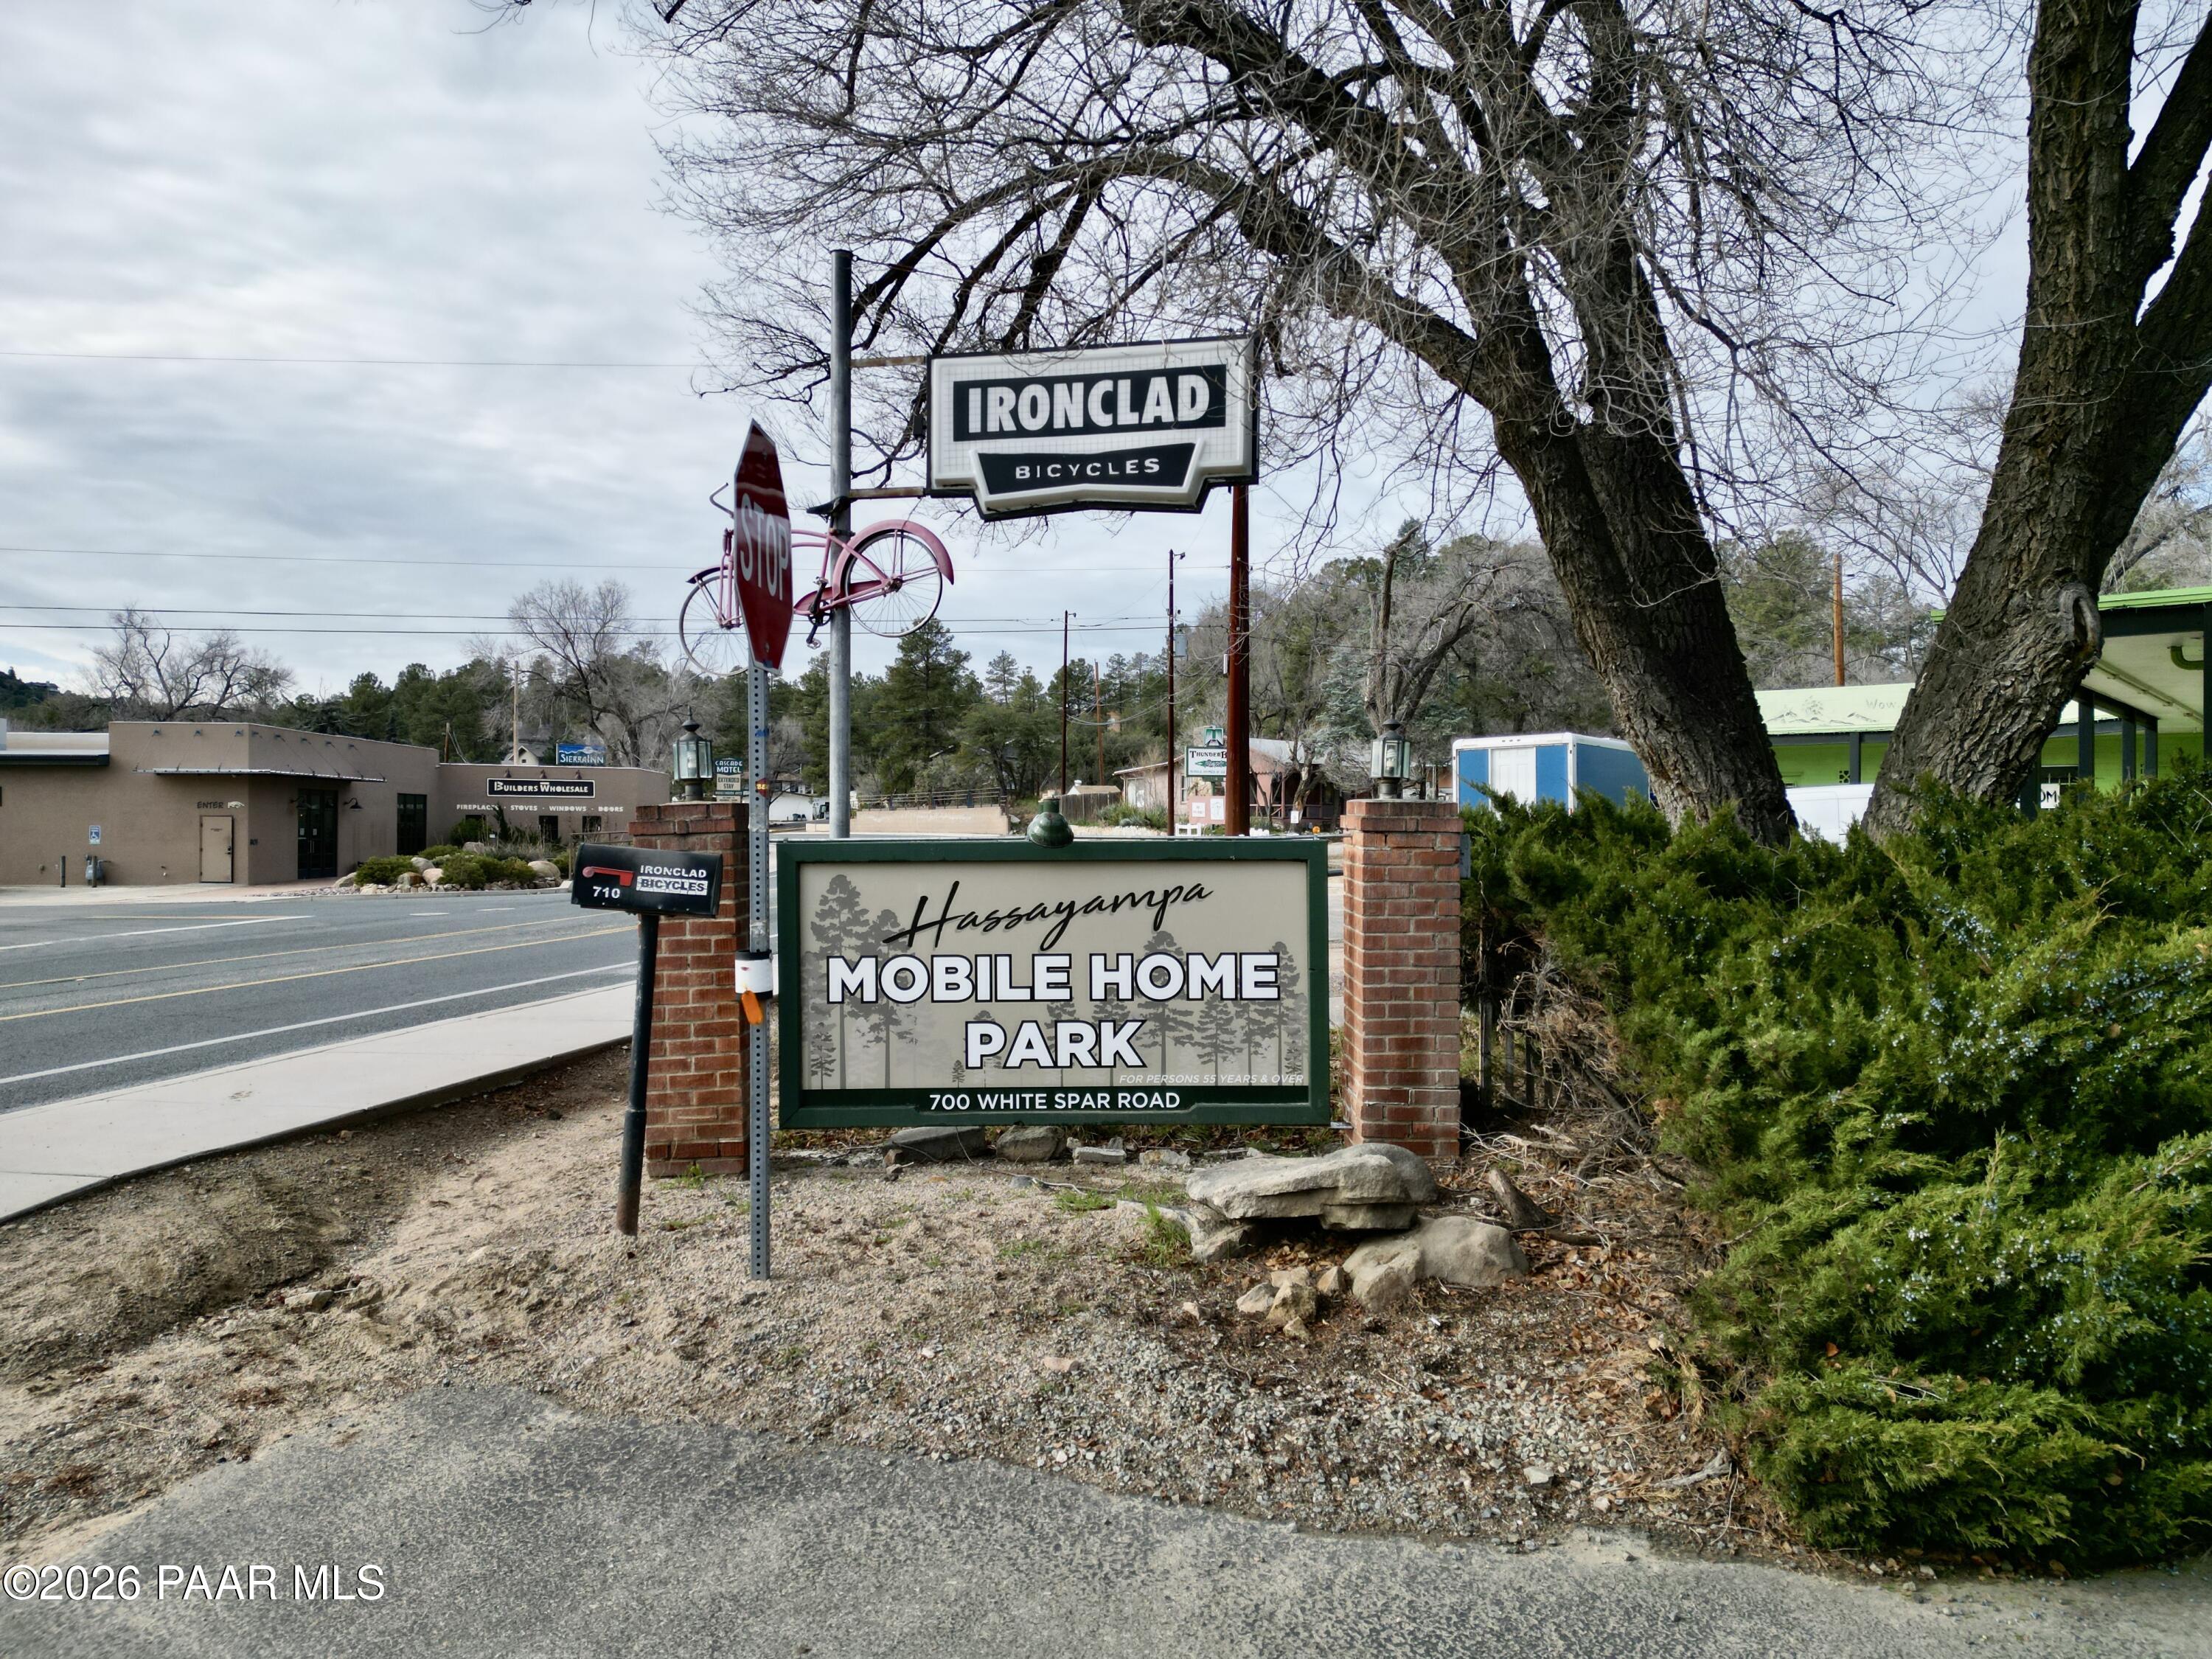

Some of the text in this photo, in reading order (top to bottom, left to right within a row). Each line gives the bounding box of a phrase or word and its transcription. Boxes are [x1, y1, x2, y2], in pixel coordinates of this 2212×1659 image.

[968, 374, 1210, 434] IRONCLAD
[1015, 458, 1161, 479] BICYCLES
[740, 493, 789, 601] STOP
[494, 781, 588, 793] BUILDERS WHOLESALE
[640, 865, 707, 878] IRONCLAD
[592, 886, 621, 899] 710
[641, 879, 706, 892] BICYCLES
[882, 880, 1214, 952] Hassayampa
[826, 951, 1281, 1004] MOBILE HOME
[964, 1018, 1148, 1071] PARK
[1119, 1074, 1304, 1084] FOR PERSONS 55 YEARS & OVER
[928, 1092, 1180, 1110] 700 WHITE SPAR ROAD
